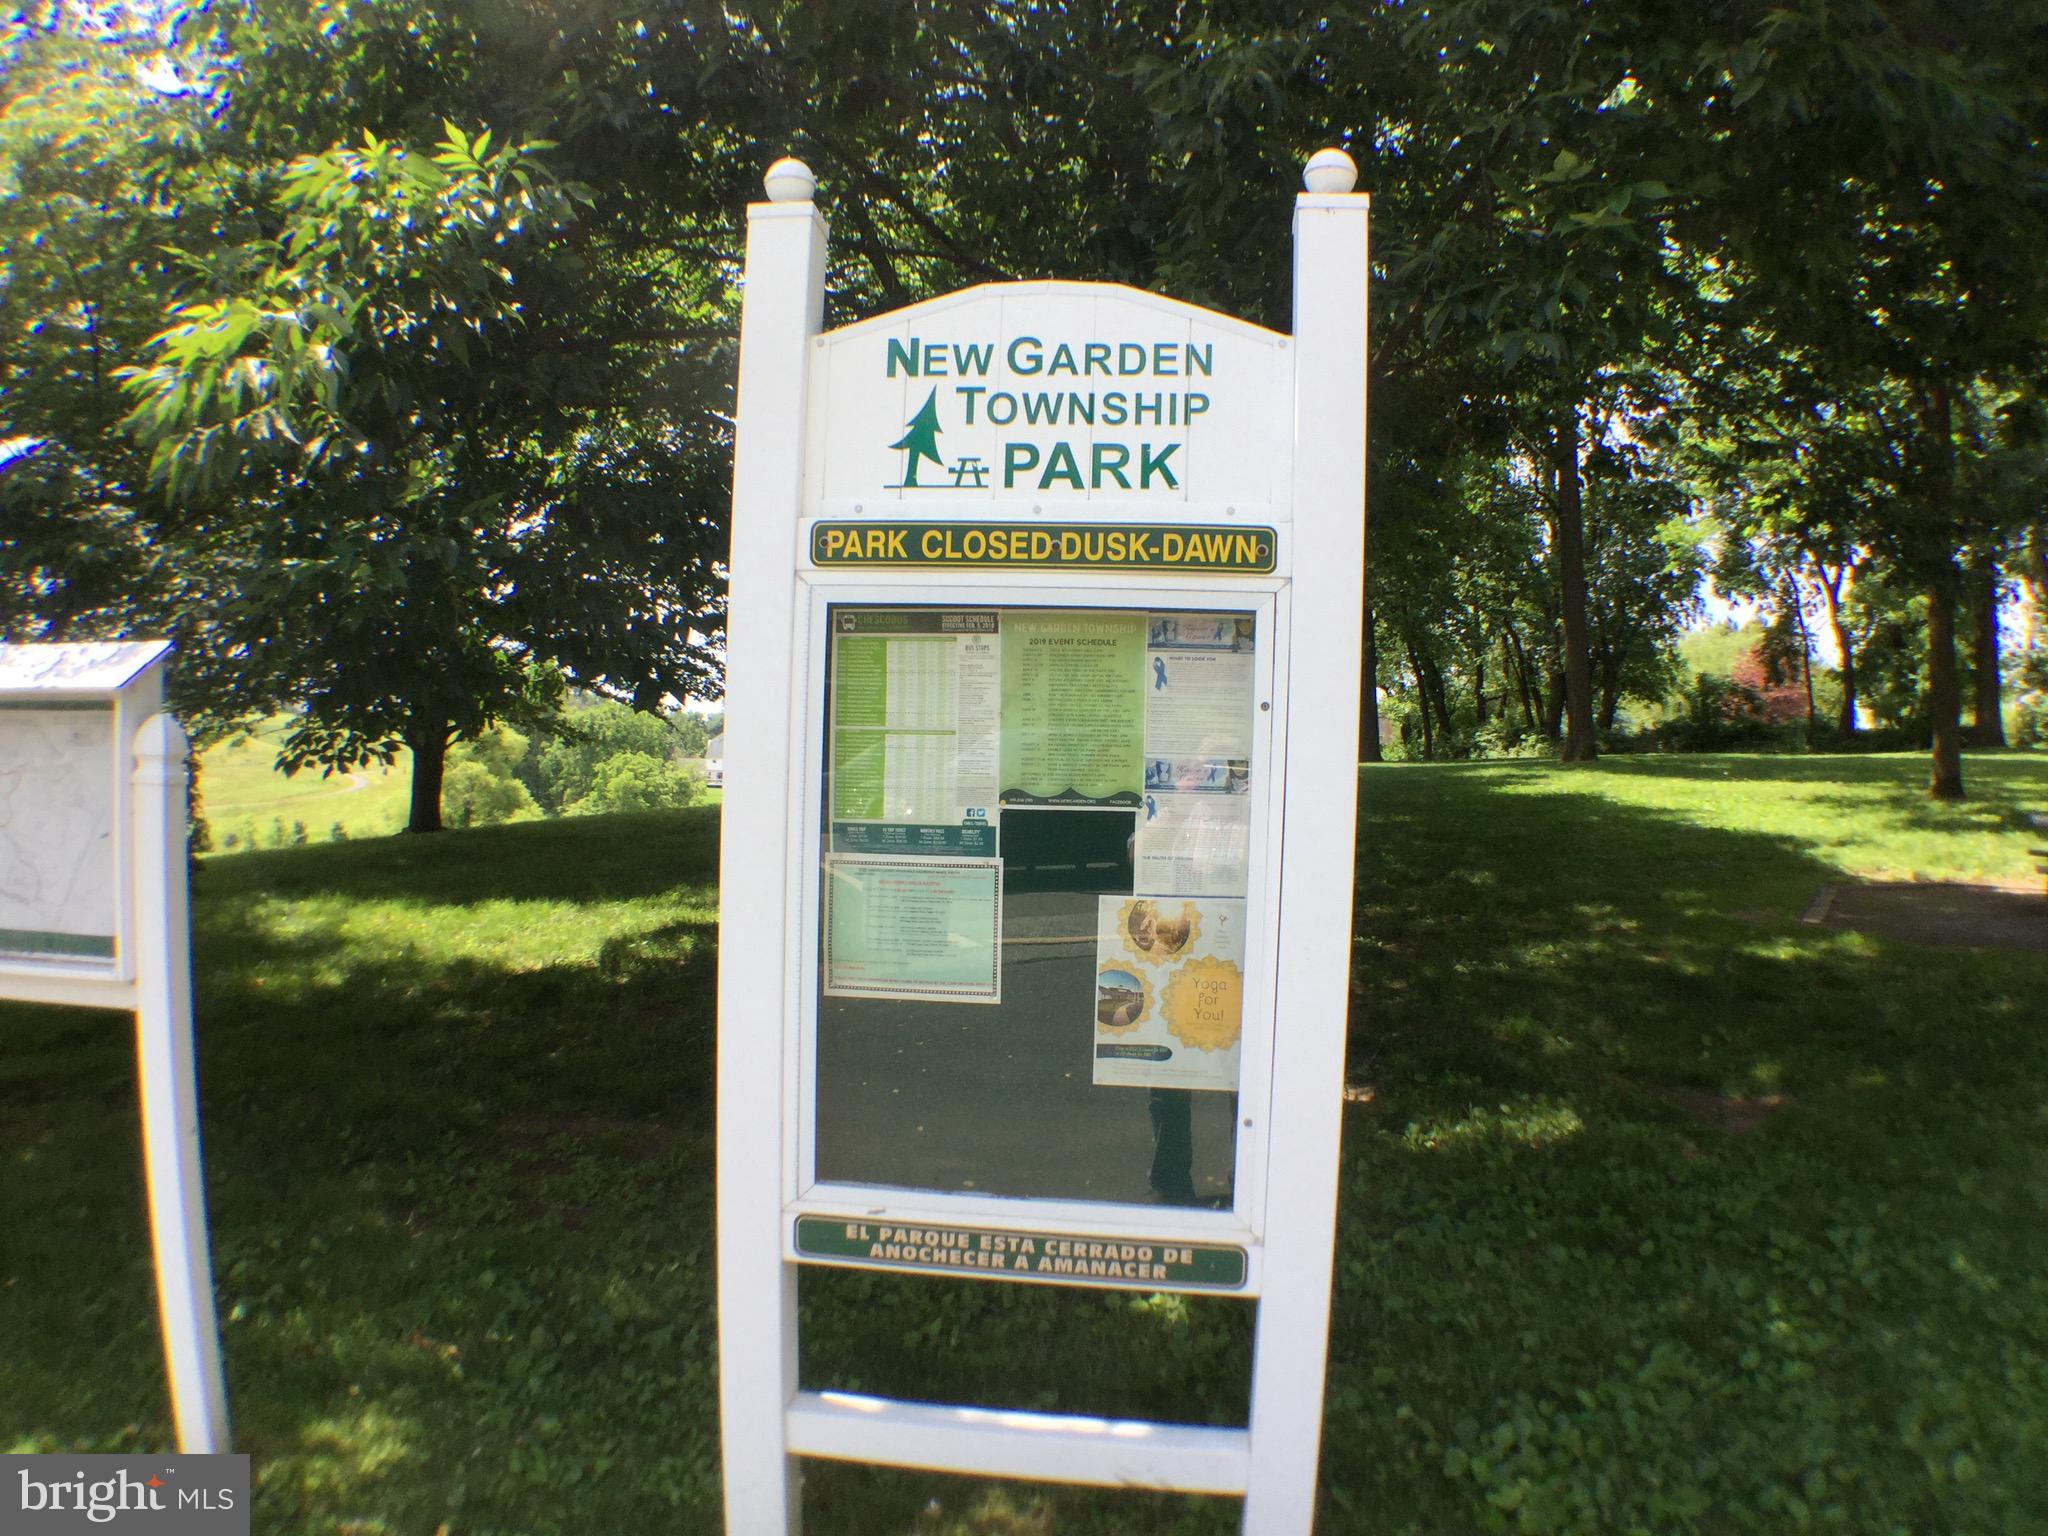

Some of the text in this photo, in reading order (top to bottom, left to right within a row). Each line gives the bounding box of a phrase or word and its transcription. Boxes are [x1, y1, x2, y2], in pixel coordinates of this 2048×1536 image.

[887, 336, 1213, 378] NEW GARDEN
[956, 386, 1211, 426] TOWNSHIP
[1004, 442, 1182, 490] PARK
[827, 530, 1257, 564] PARK CLOSED DUSK-DAWN
[1014, 623, 1138, 634] NEW GARDEN TOWNSHIP
[1192, 978, 1227, 992] Yoga
[1194, 1008, 1224, 1022] You!
[846, 1224, 1193, 1265] EL PARQUE ESTA CERRADO DE
[870, 1243, 1167, 1280] ANOCHECER A AMANACER
